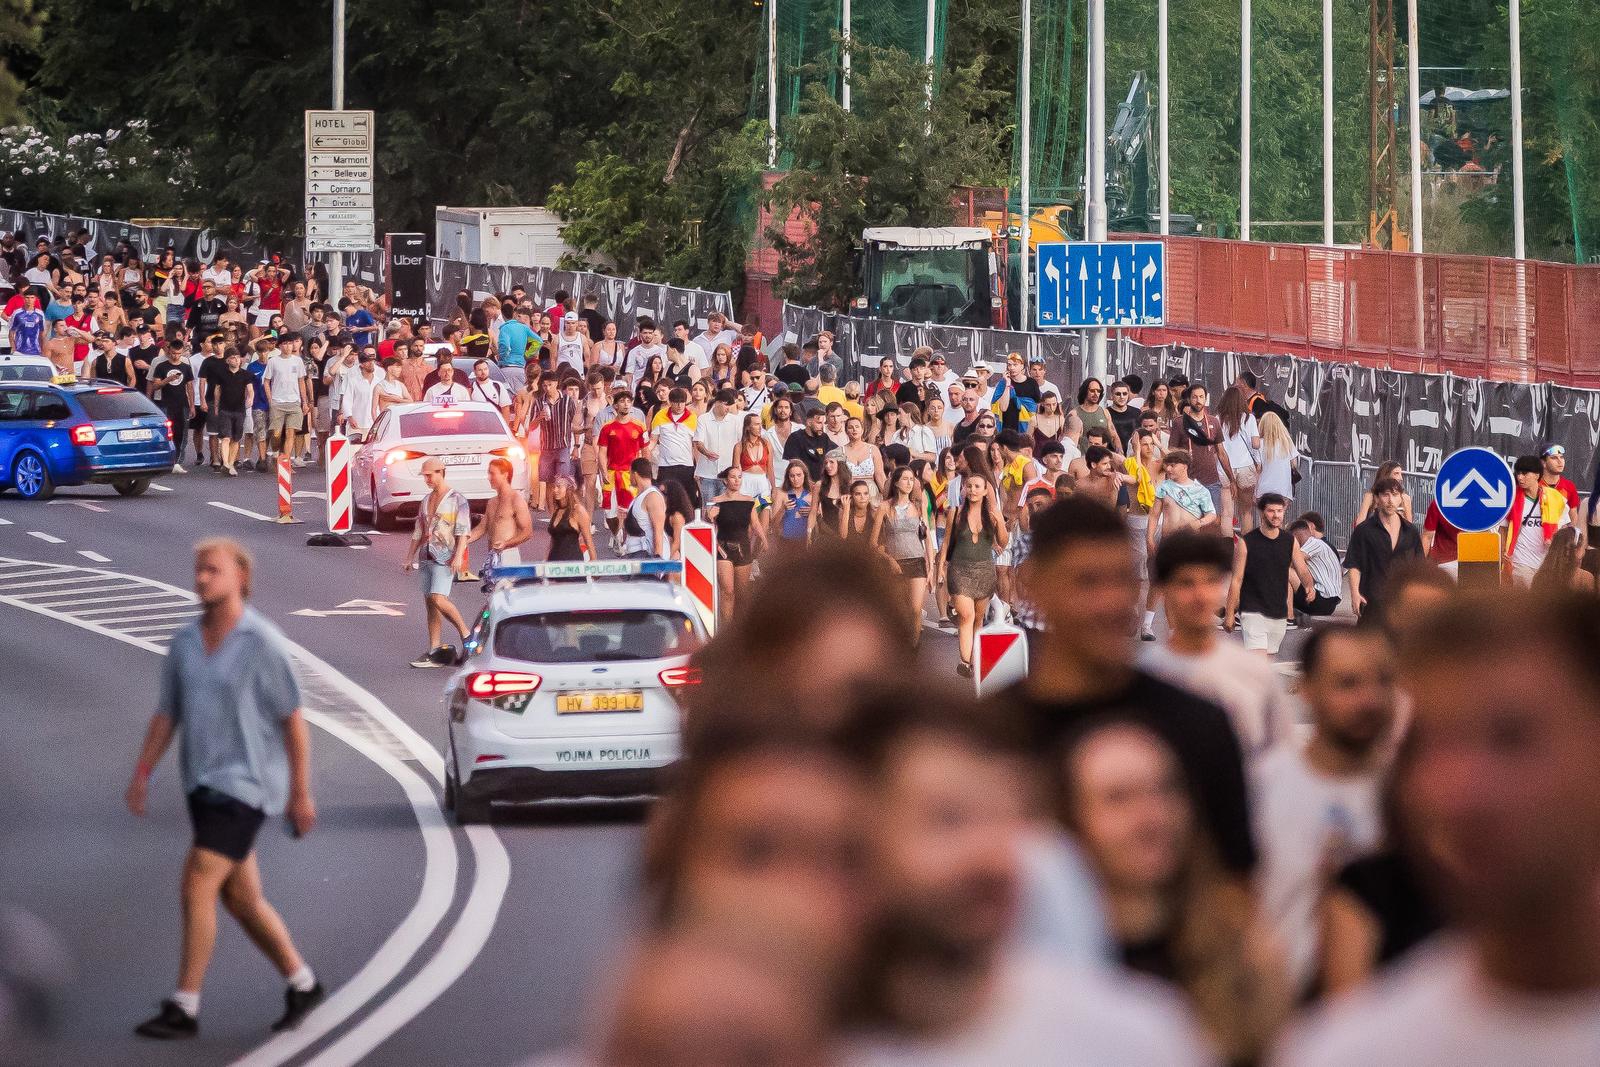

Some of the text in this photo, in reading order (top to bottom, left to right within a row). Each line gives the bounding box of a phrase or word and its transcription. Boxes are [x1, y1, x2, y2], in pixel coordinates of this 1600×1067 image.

[315, 119, 345, 128] HOTEL
[342, 138, 366, 146] Globo
[333, 156, 368, 164] Marmont
[334, 169, 367, 178] Bellevue
[330, 185, 361, 193] Cornaro
[393, 254, 423, 266] Uber
[392, 307, 417, 316] Pickup
[549, 564, 628, 576] VOJNA POLICIJA
[566, 696, 582, 711] HV
[556, 749, 651, 762] VOJNA POLICIJA
